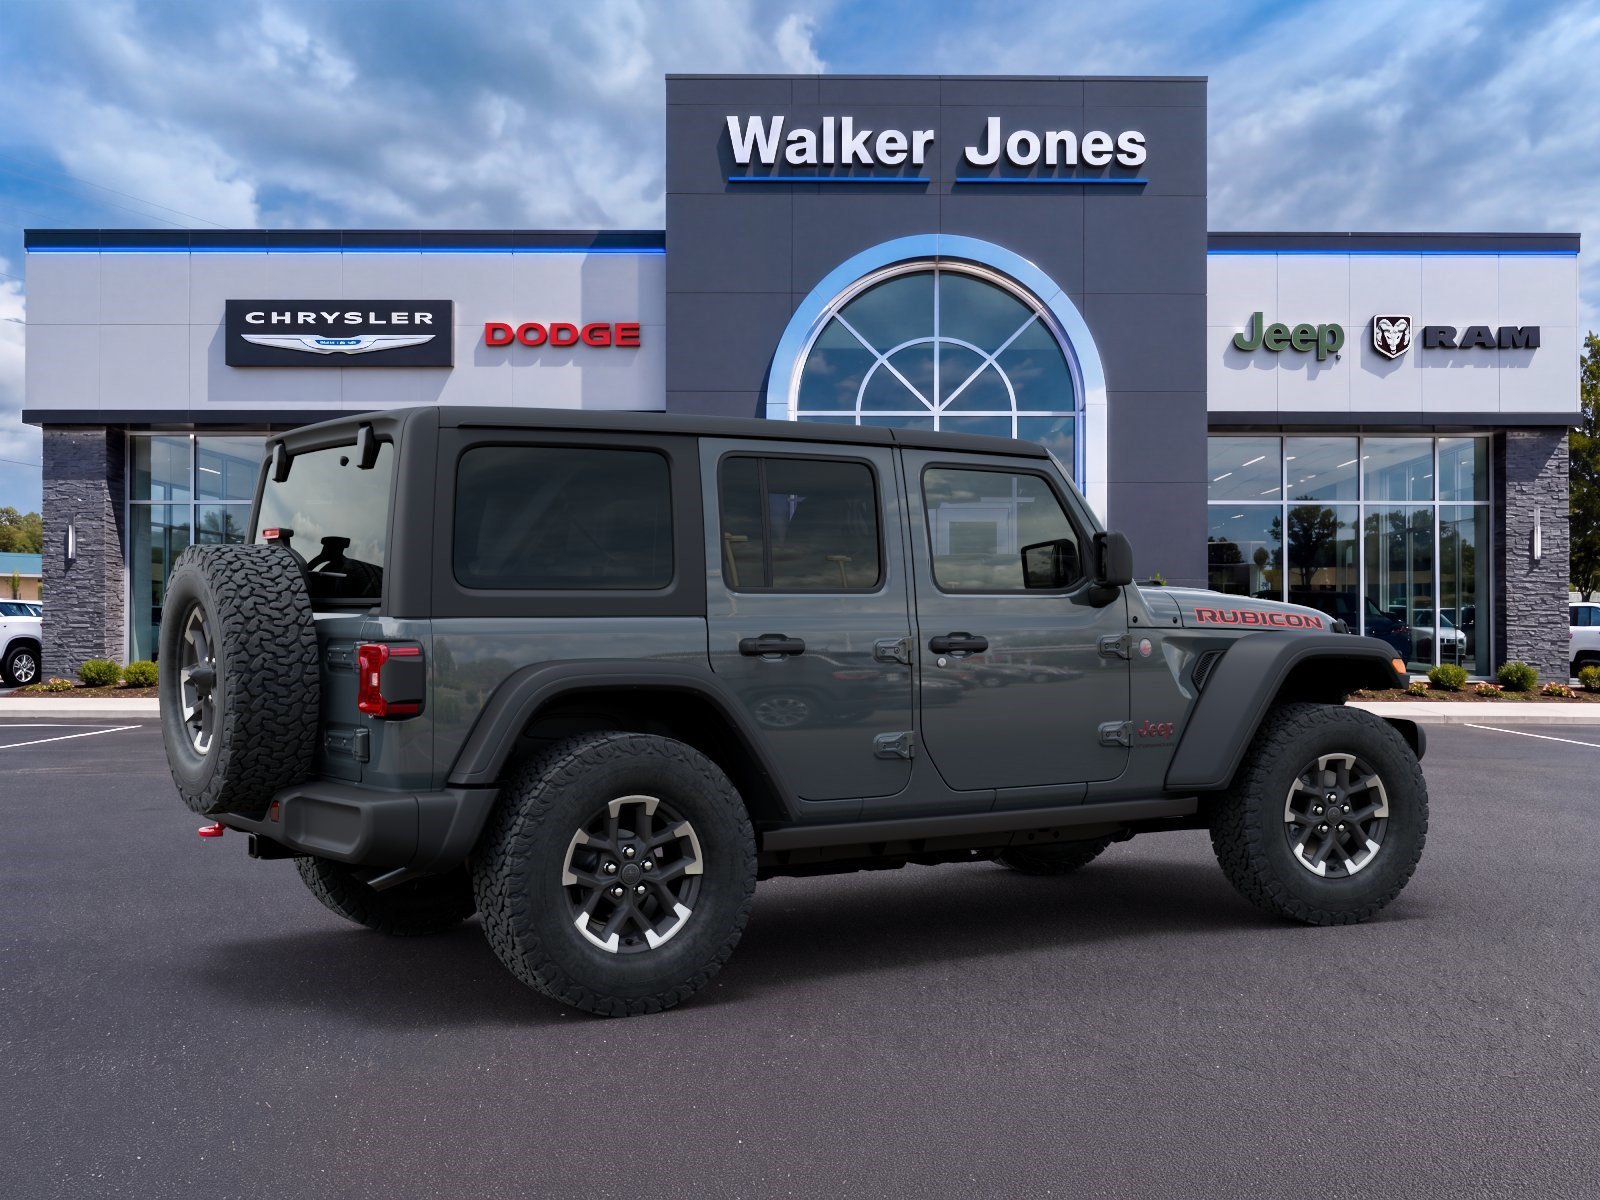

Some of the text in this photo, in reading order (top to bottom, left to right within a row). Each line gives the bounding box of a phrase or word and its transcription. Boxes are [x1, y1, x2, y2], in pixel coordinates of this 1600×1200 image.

[726, 115, 1148, 167] Walker Jones
[244, 311, 434, 326] CHRYSLER
[484, 322, 641, 348] DODGE
[1233, 311, 1345, 361] Jeep
[1422, 325, 1541, 349] RAM
[1194, 607, 1324, 630] RUBICON
[1137, 719, 1176, 740] Jeep
